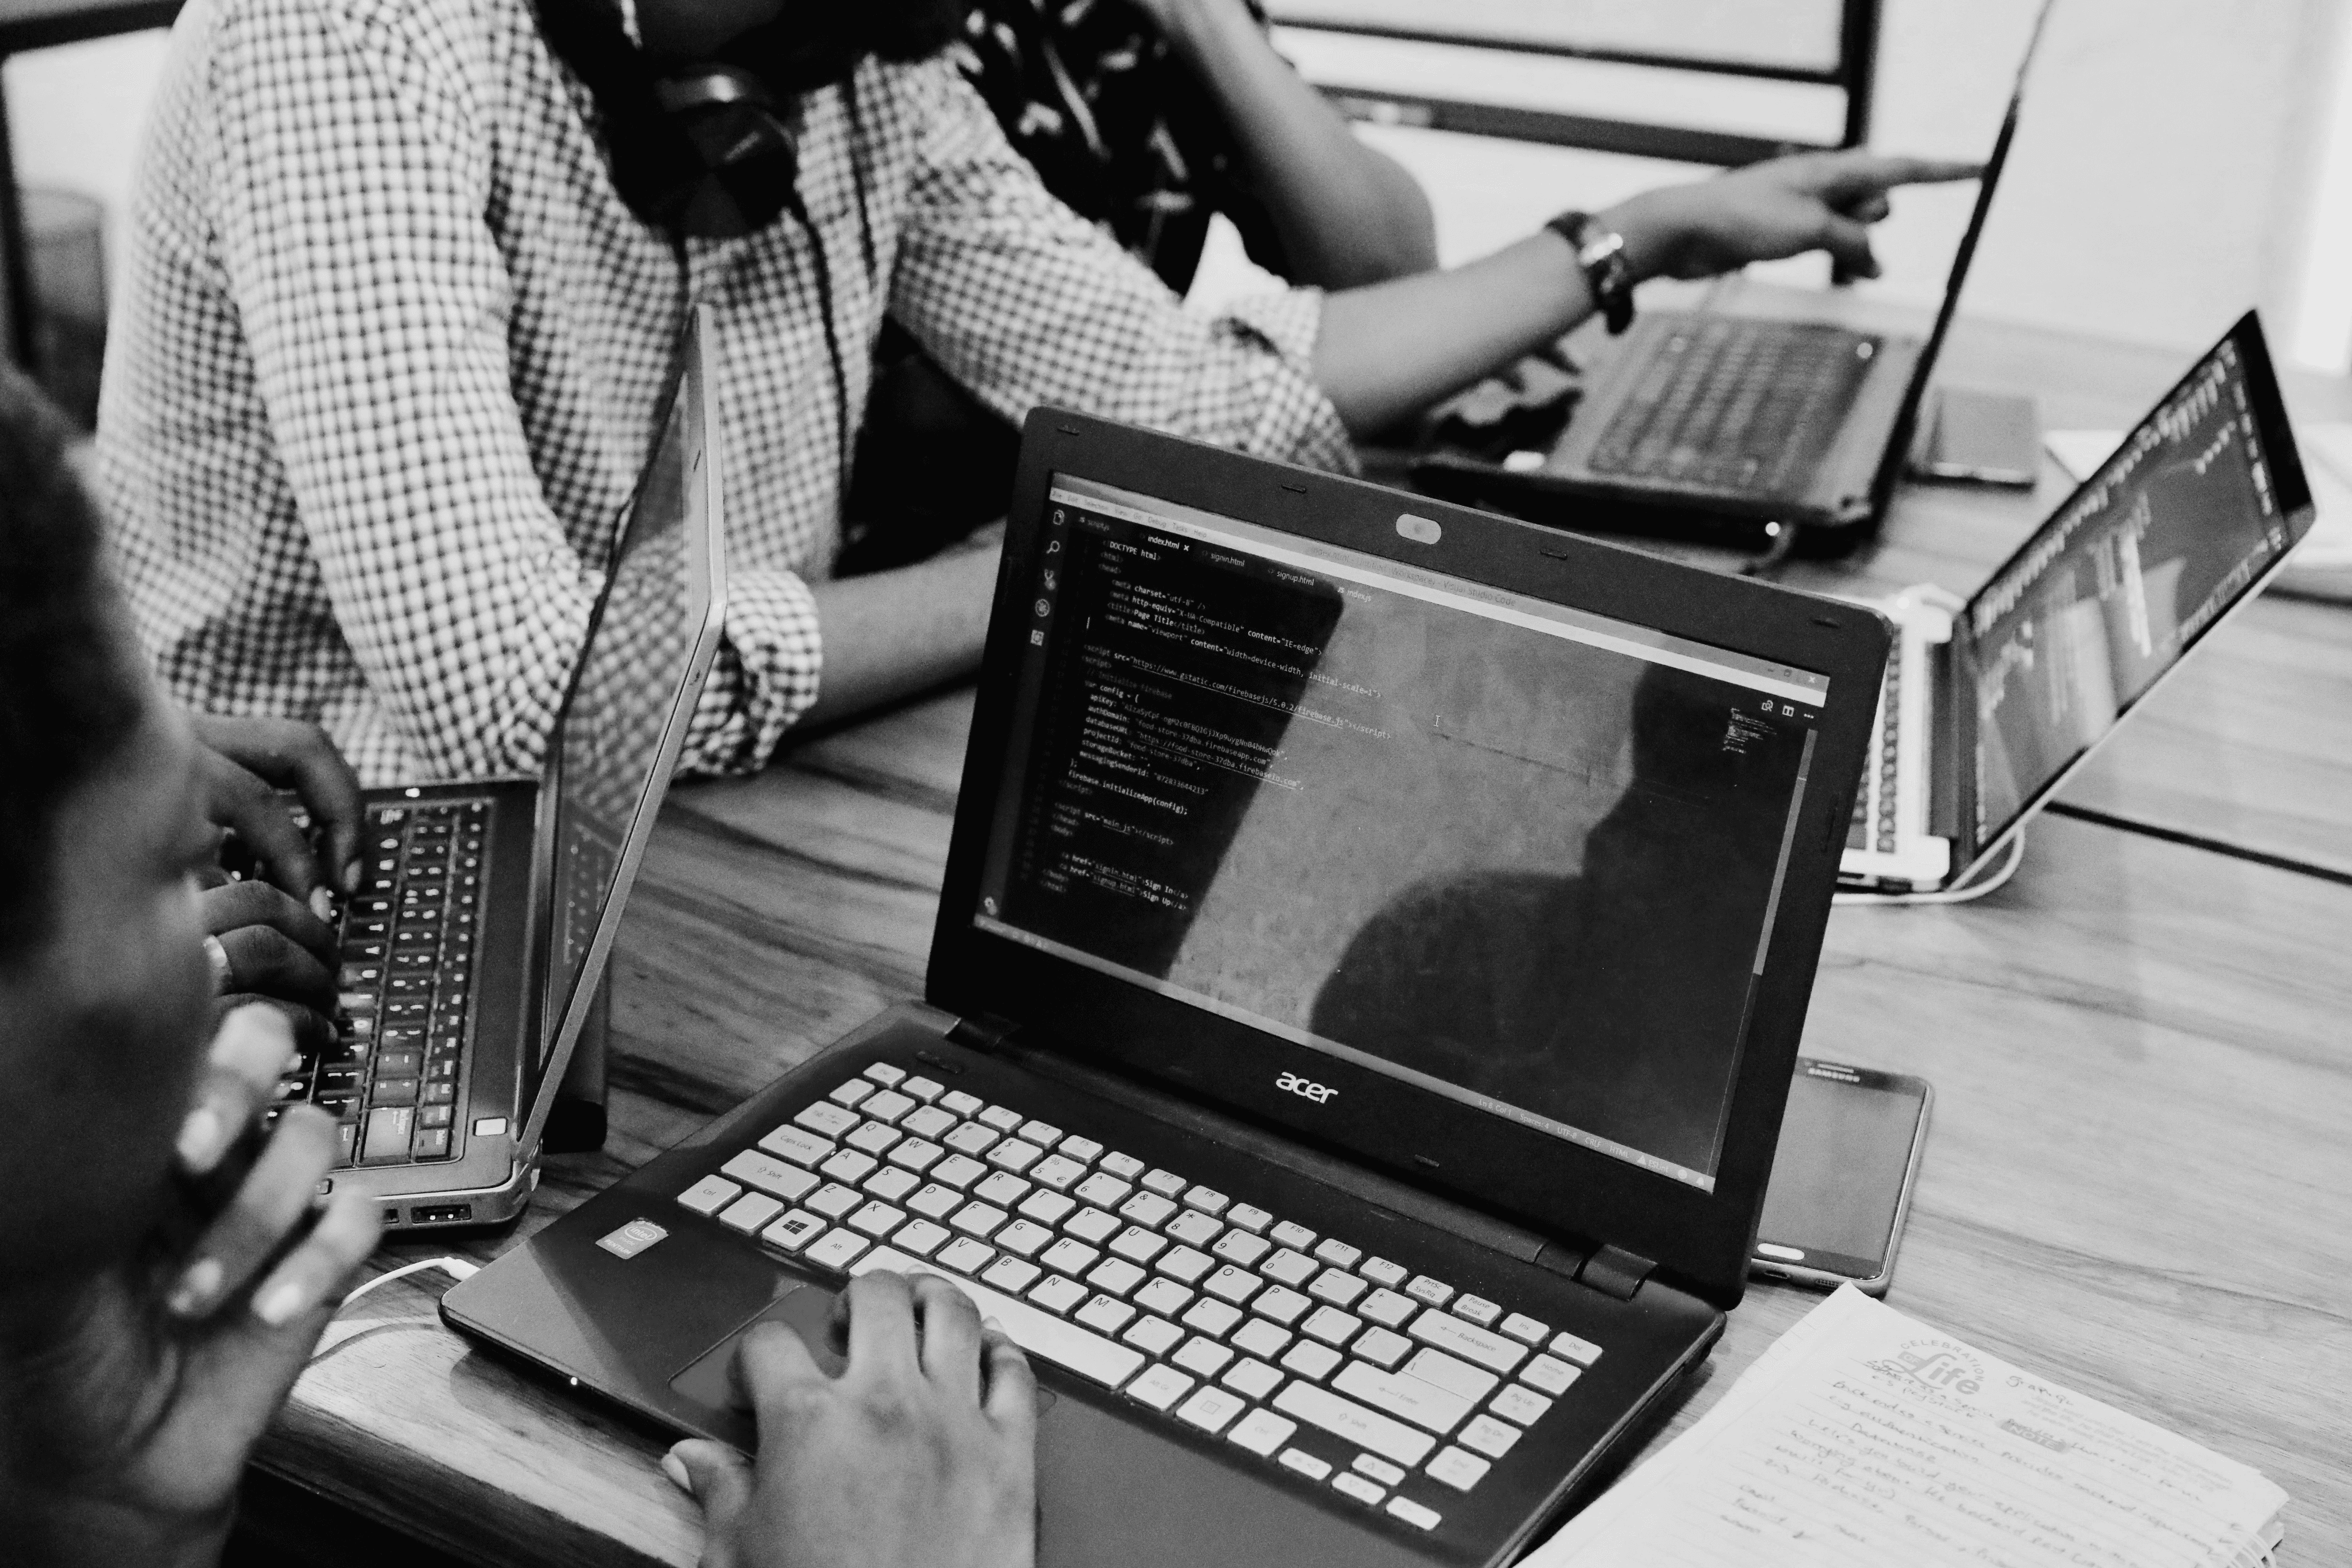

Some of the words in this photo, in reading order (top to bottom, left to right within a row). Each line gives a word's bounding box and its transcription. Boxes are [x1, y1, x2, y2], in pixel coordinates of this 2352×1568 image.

[1148, 516, 1166, 527] Debug
[1173, 522, 1187, 532] Tasks
[1147, 536, 1179, 549] index.html
[1140, 549, 1162, 560] html>
[1210, 553, 1245, 567] signin.html
[1276, 571, 1314, 586] signup.html
[1134, 585, 1194, 606] charset="utf-8"
[1337, 586, 1345, 597] JS
[1346, 590, 1370, 603] index.js
[1444, 581, 1465, 593] Visual
[1468, 589, 1492, 600] Studio
[1495, 597, 1515, 606] Code
[1132, 596, 1244, 632] http-equiv="X-UA-Compatible"
[1247, 630, 1321, 655] content="IE=edge">
[1128, 621, 1187, 641] name="viewport"
[1191, 639, 1304, 676] content="width=device-width,
[1309, 672, 1381, 698] initial-scale=1">
[1100, 685, 1124, 699] config
[1090, 694, 1116, 707] apiKey:
[1088, 706, 1130, 722] authDomain:
[1069, 770, 1188, 815] firebase.initializeApp(config);
[1276, 1071, 1339, 1104] acer
[865, 1099, 873, 1107] 1
[865, 1124, 877, 1132] Q
[780, 1135, 796, 1144] Caps
[908, 1140, 923, 1148] W
[1519, 1113, 1544, 1127] Spaces:
[1557, 1126, 1578, 1139] UTF-8
[1584, 1136, 1601, 1147] CRLF
[1608, 1144, 1630, 1158] HTML
[1647, 1159, 1669, 1172] ESLint
[767, 1171, 782, 1179] Shift
[1035, 1166, 1045, 1174] 5
[993, 1173, 1004, 1181] R
[824, 1185, 837, 1193] Z
[924, 1186, 937, 1194] D
[868, 1203, 881, 1211] X
[1084, 1209, 1095, 1217] Y
[1015, 1222, 1026, 1230] G
[1290, 1225, 1304, 1233] F10
[630, 1226, 653, 1240] intel
[1128, 1228, 1140, 1236] U
[619, 1236, 636, 1246] inside
[958, 1239, 969, 1247] V
[1058, 1240, 1071, 1249] H
[604, 1238, 632, 1255] PENTIUM
[1334, 1243, 1349, 1251] F11
[1000, 1258, 1012, 1266] B
[1379, 1261, 1394, 1271] F12
[1223, 1268, 1234, 1276] O
[1047, 1277, 1061, 1286] N
[1152, 1280, 1165, 1288] K
[1423, 1279, 1438, 1289] PrtSc
[1414, 1286, 1436, 1298] SysRq
[1094, 1297, 1110, 1307] M
[1200, 1300, 1208, 1308] L
[1468, 1297, 1492, 1308] Pause
[1460, 1304, 1481, 1316] Break
[1519, 1322, 1529, 1330] Ins
[1457, 1333, 1496, 1351] Backspace
[1901, 1339, 1984, 1383] CELEBRATION
[2011, 1426, 2061, 1450] NOTE
